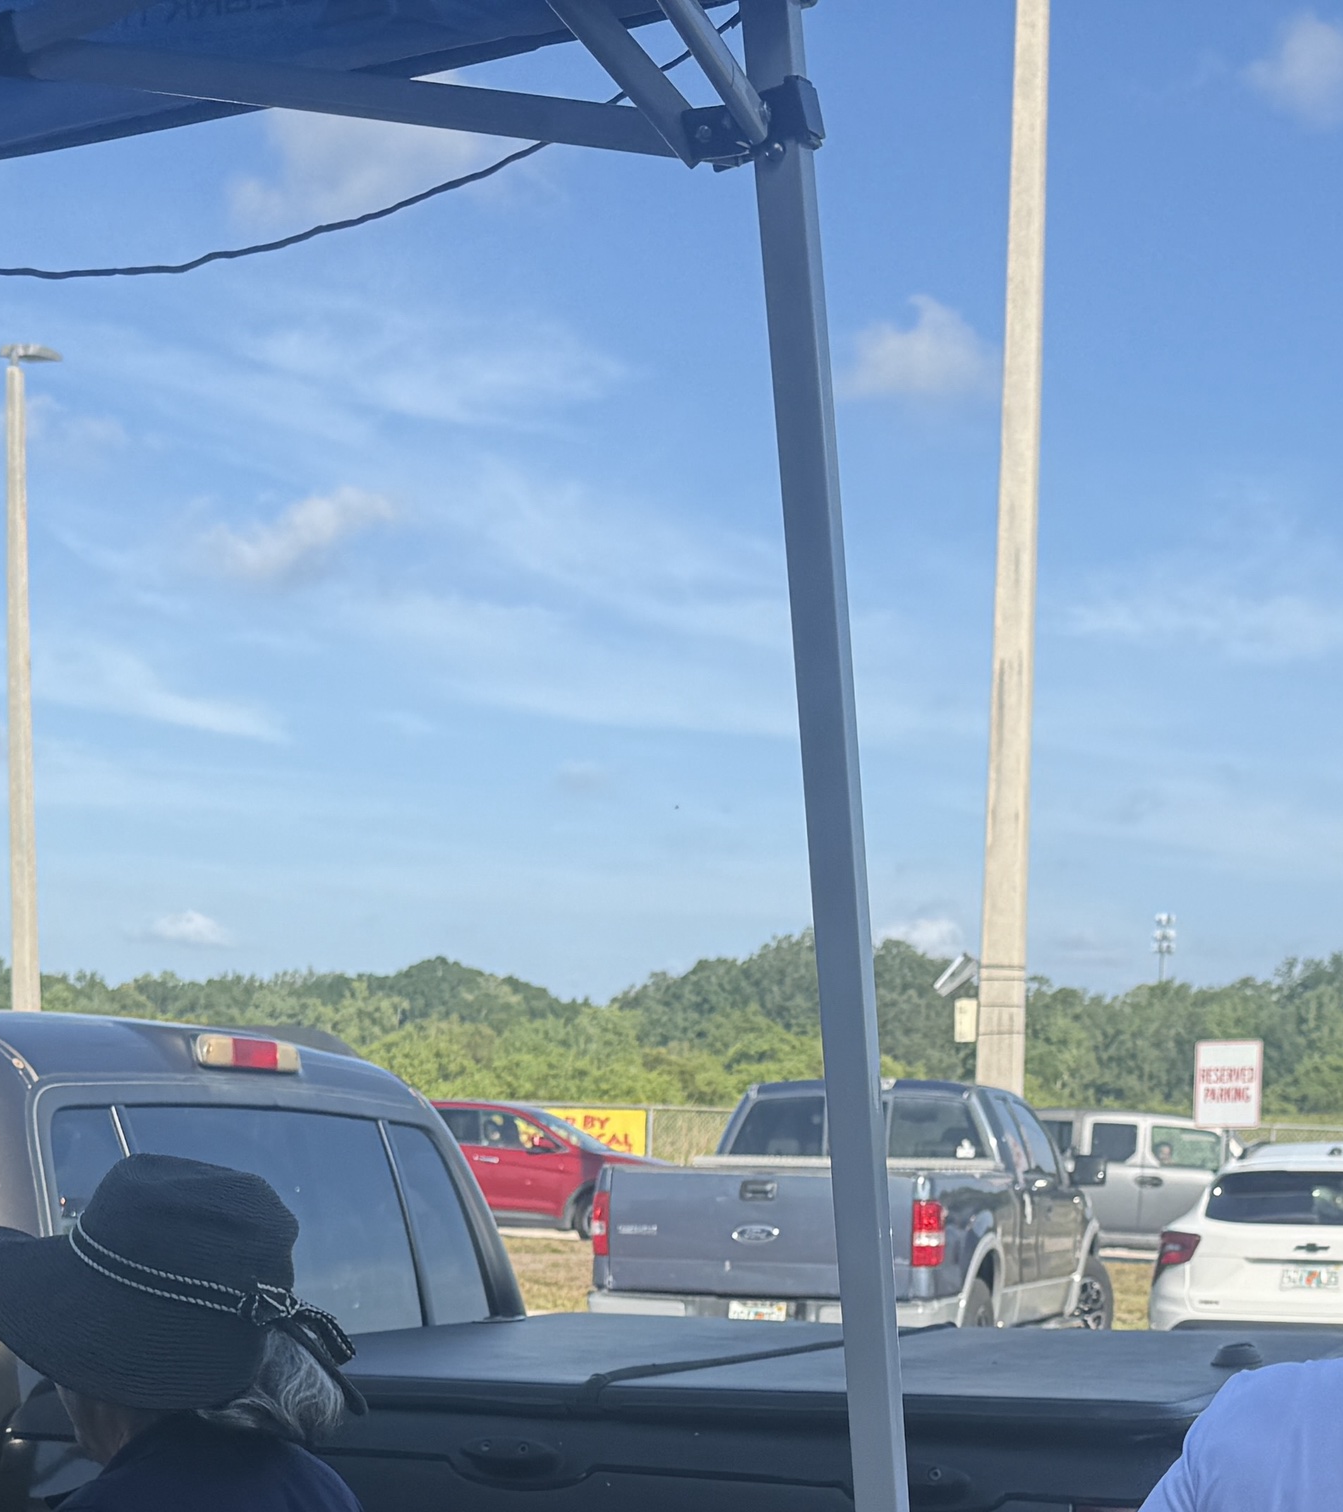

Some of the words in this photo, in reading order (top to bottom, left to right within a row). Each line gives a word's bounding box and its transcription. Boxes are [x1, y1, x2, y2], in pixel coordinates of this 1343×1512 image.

[1200, 1067, 1254, 1084] RESERVED
[1204, 1087, 1251, 1103] PARKING
[583, 1115, 610, 1130] BY
